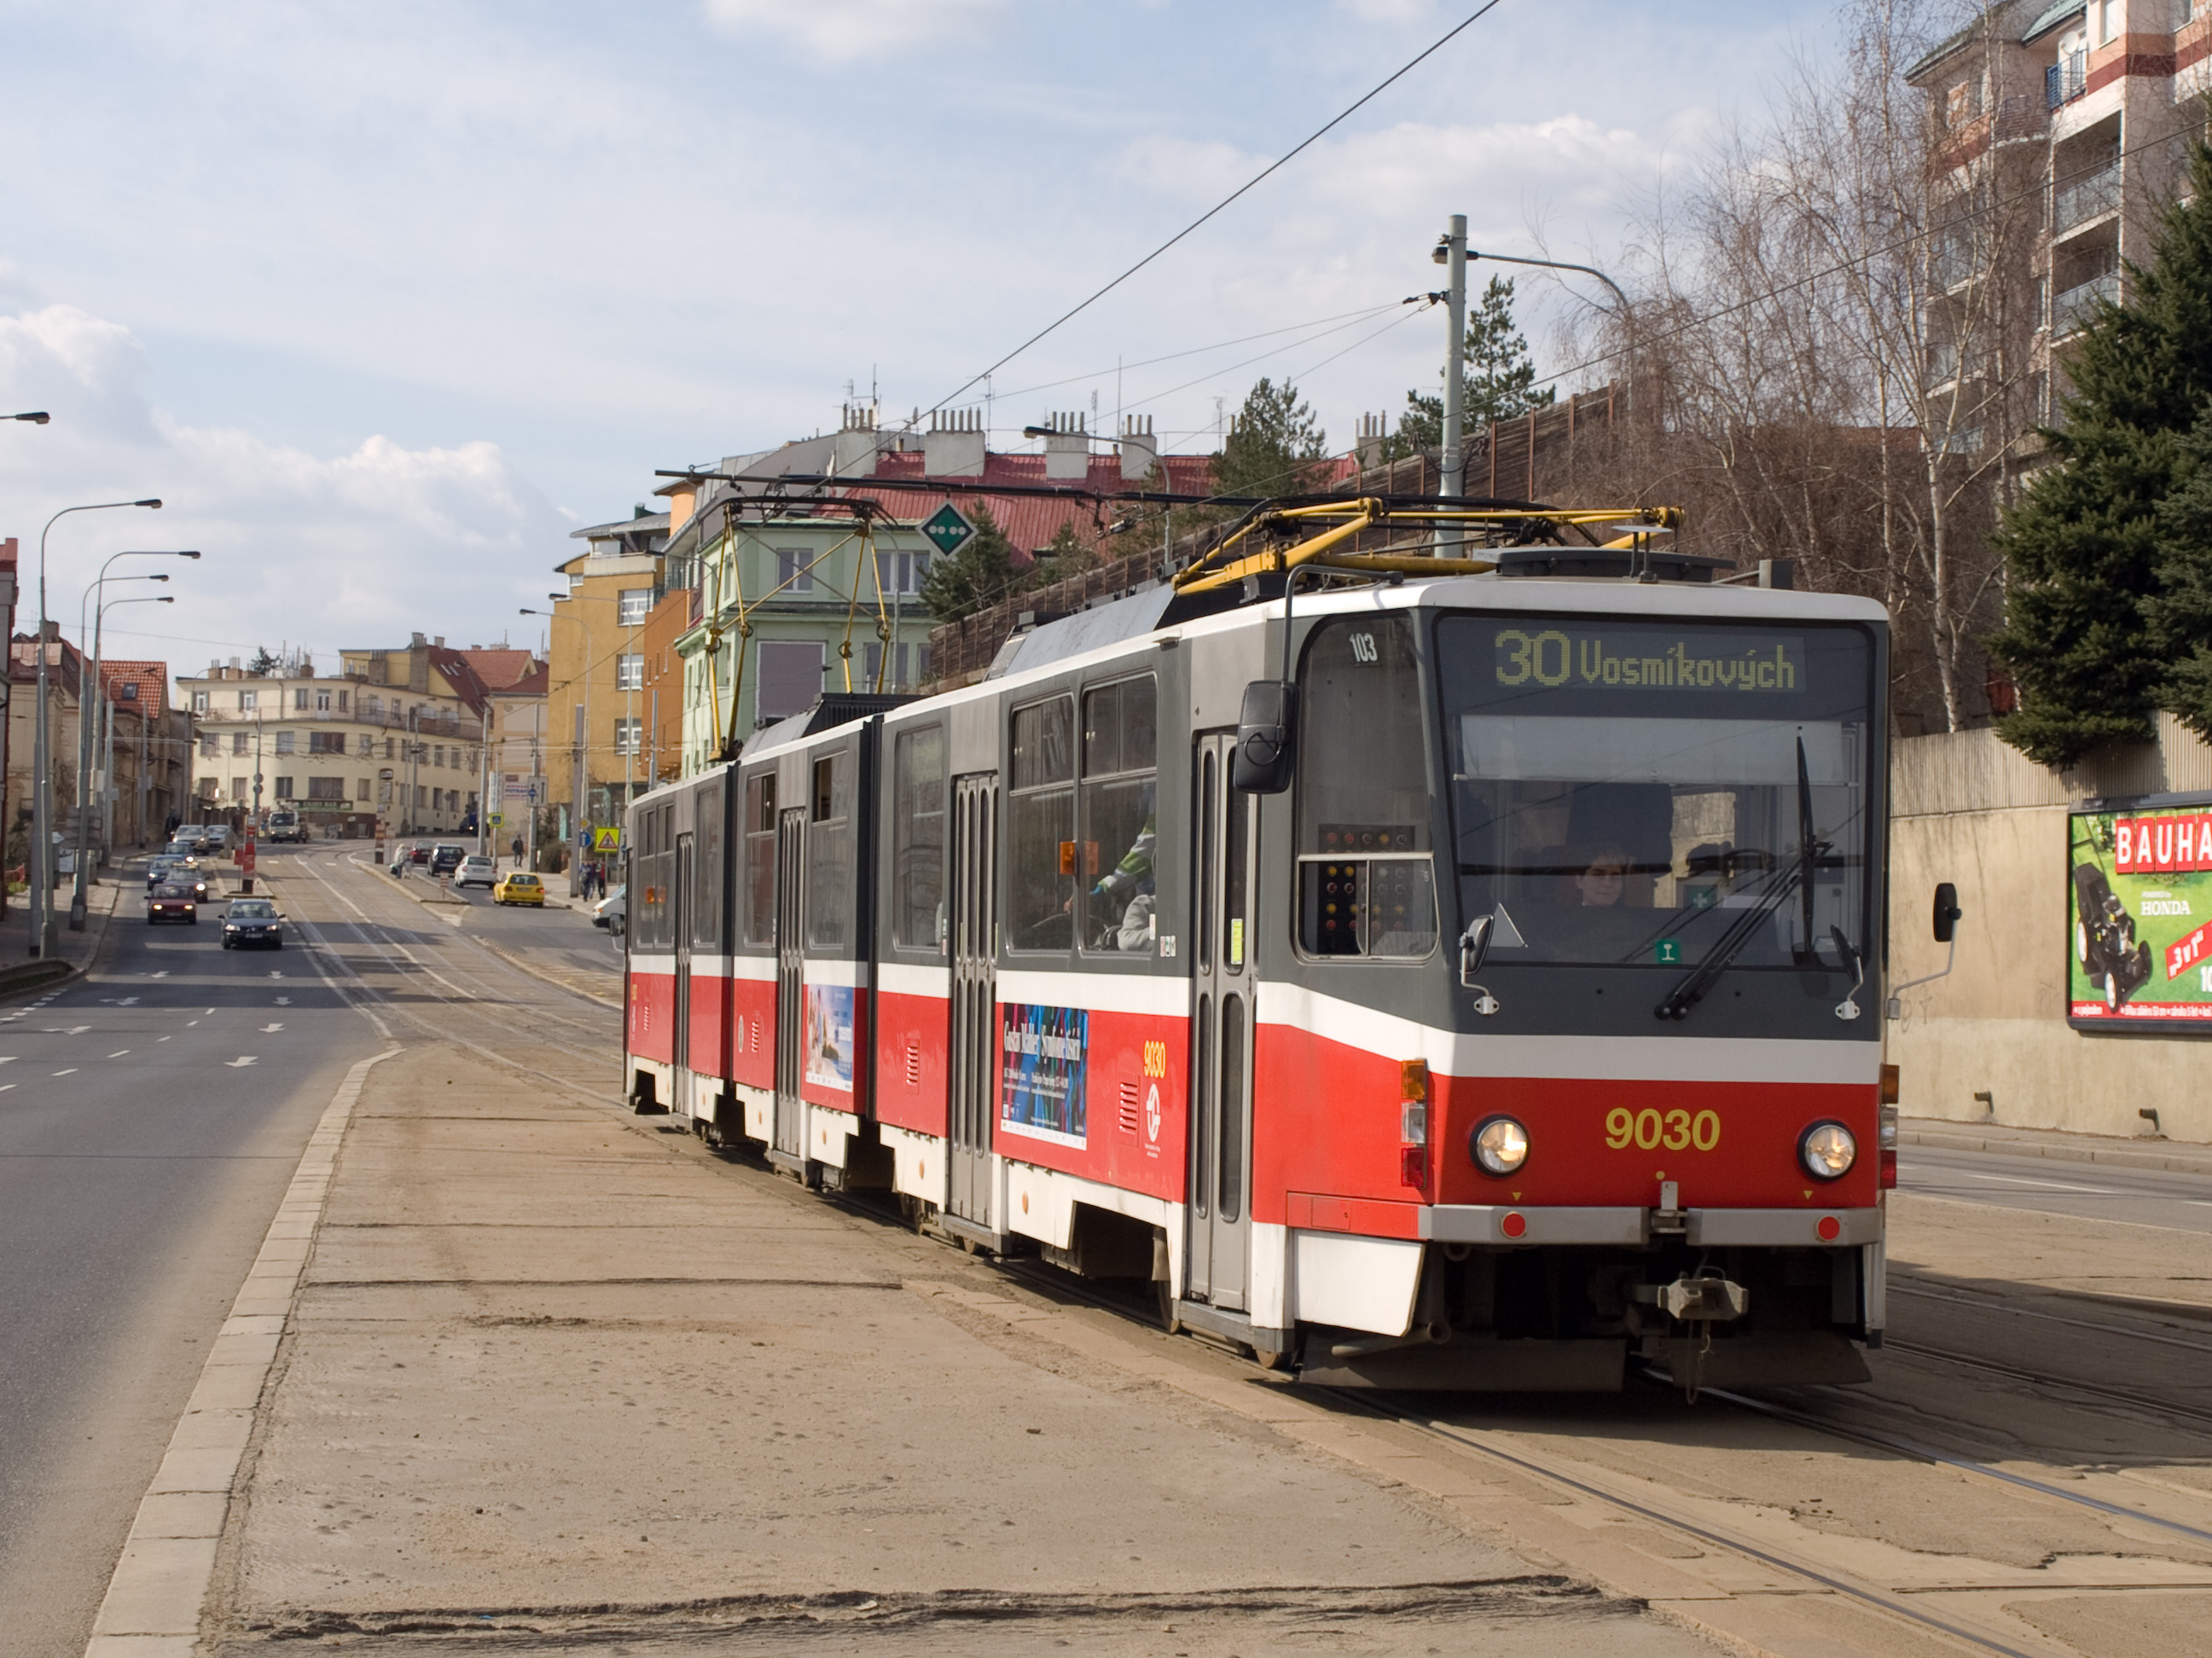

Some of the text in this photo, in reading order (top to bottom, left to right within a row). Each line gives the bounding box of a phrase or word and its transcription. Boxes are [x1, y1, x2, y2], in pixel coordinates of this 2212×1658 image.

[1349, 632, 1378, 662] 103
[1495, 629, 1795, 691] 30 Vosmíkových
[2117, 820, 2212, 865] BAUHA
[2140, 901, 2192, 916] HONDA
[1143, 1039, 1167, 1079] 9030
[1605, 1106, 1721, 1152] 9030
